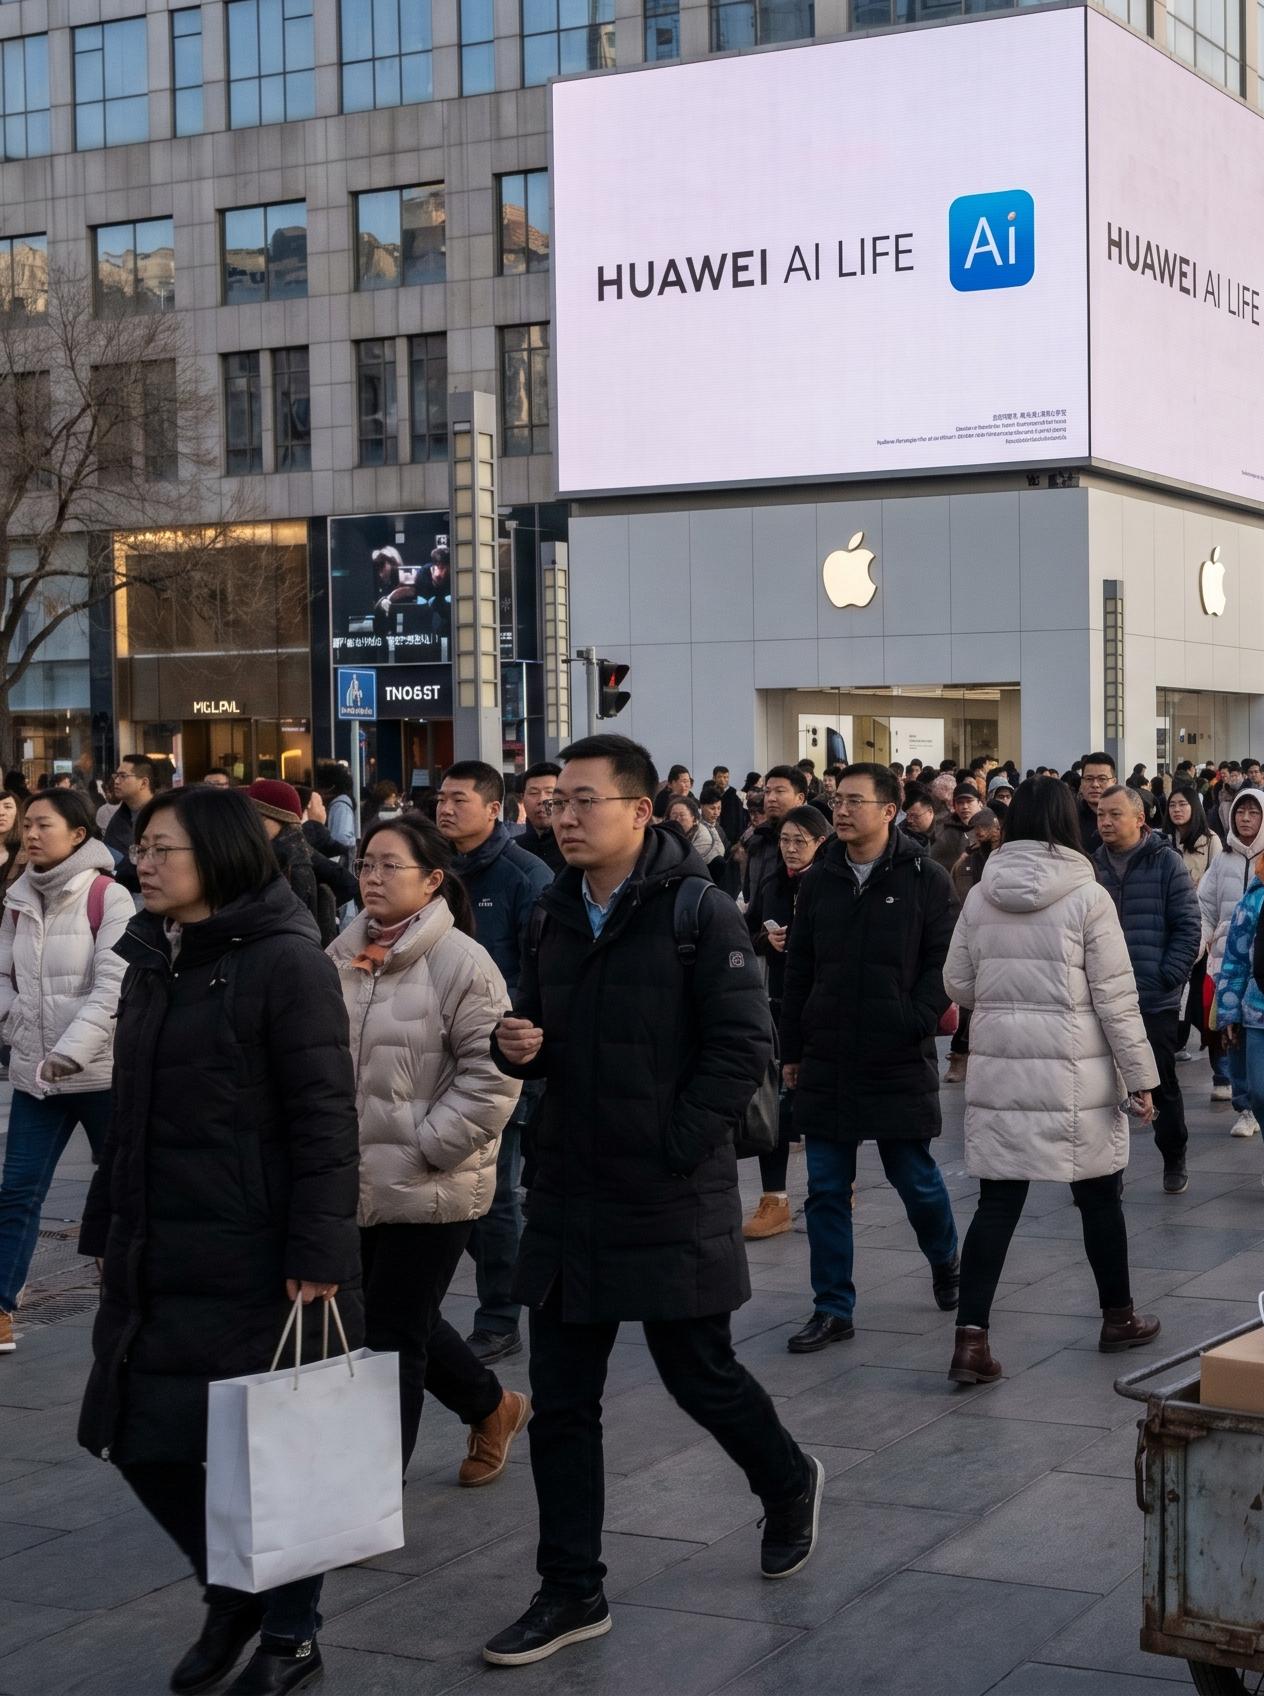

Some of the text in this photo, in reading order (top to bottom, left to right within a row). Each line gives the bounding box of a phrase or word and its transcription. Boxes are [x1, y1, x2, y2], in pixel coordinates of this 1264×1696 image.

[597, 232, 914, 302] HUAWEI AI LIFE
[965, 211, 1015, 269] Ai
[1107, 221, 1260, 327] HUAWEI AI LIFE
